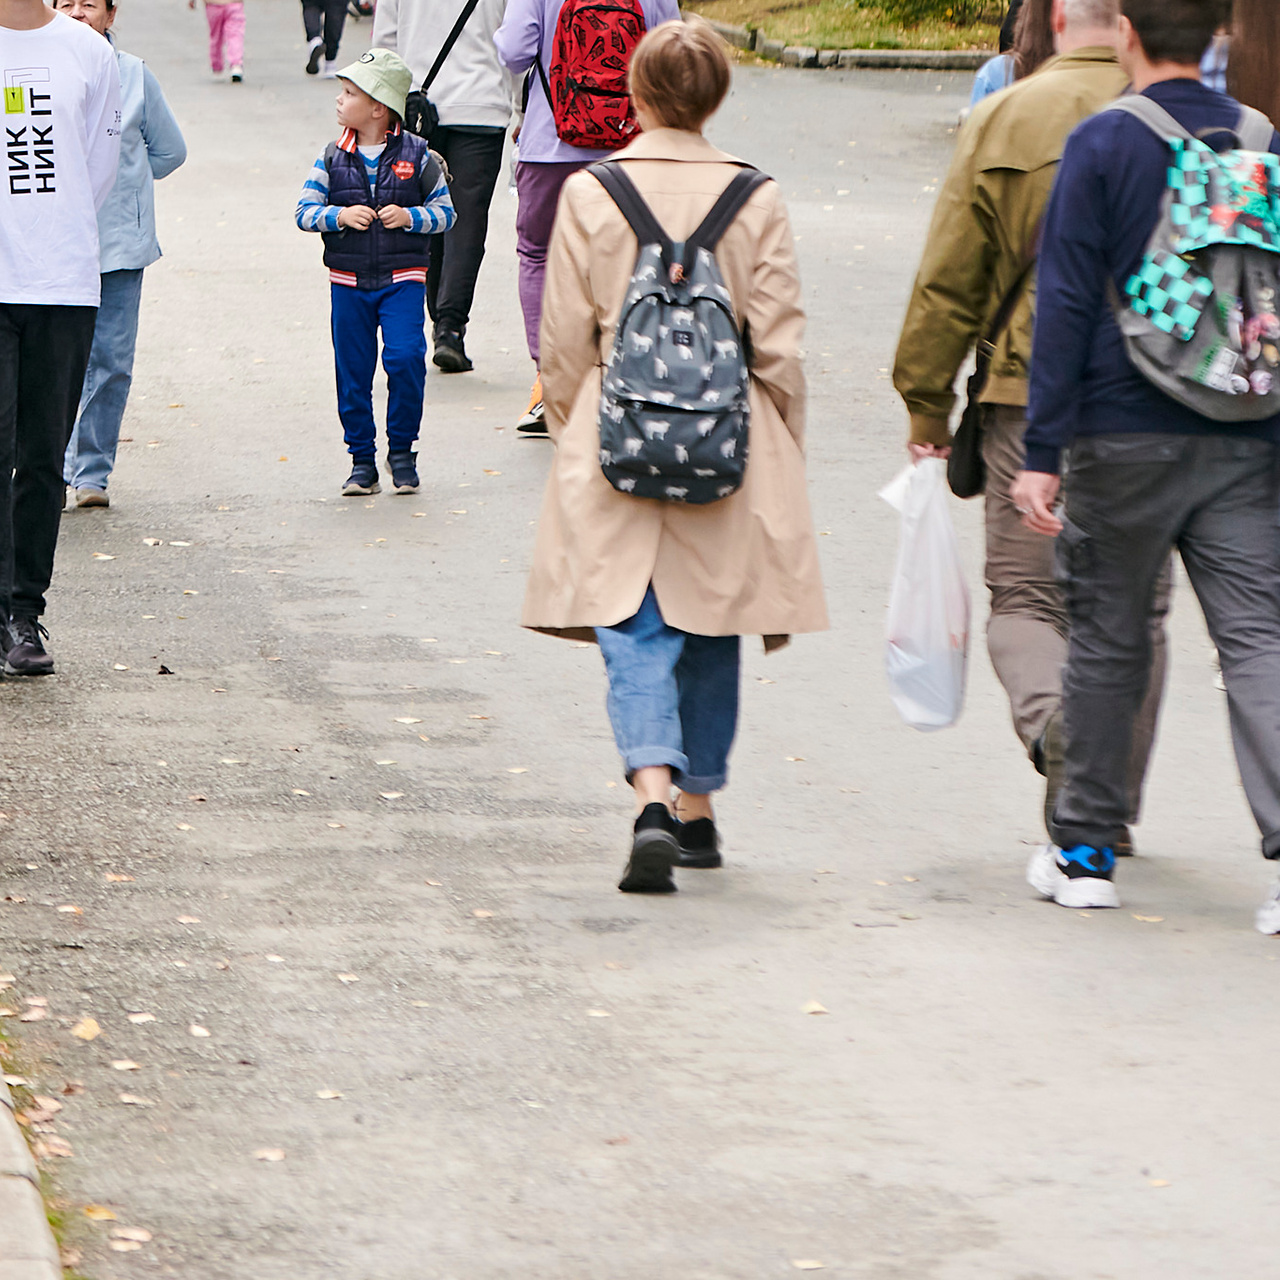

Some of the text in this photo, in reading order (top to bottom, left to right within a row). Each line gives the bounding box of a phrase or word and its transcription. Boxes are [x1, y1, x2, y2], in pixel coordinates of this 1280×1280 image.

[6, 126, 31, 194] ПИК
[29, 88, 56, 193] НИК IT
